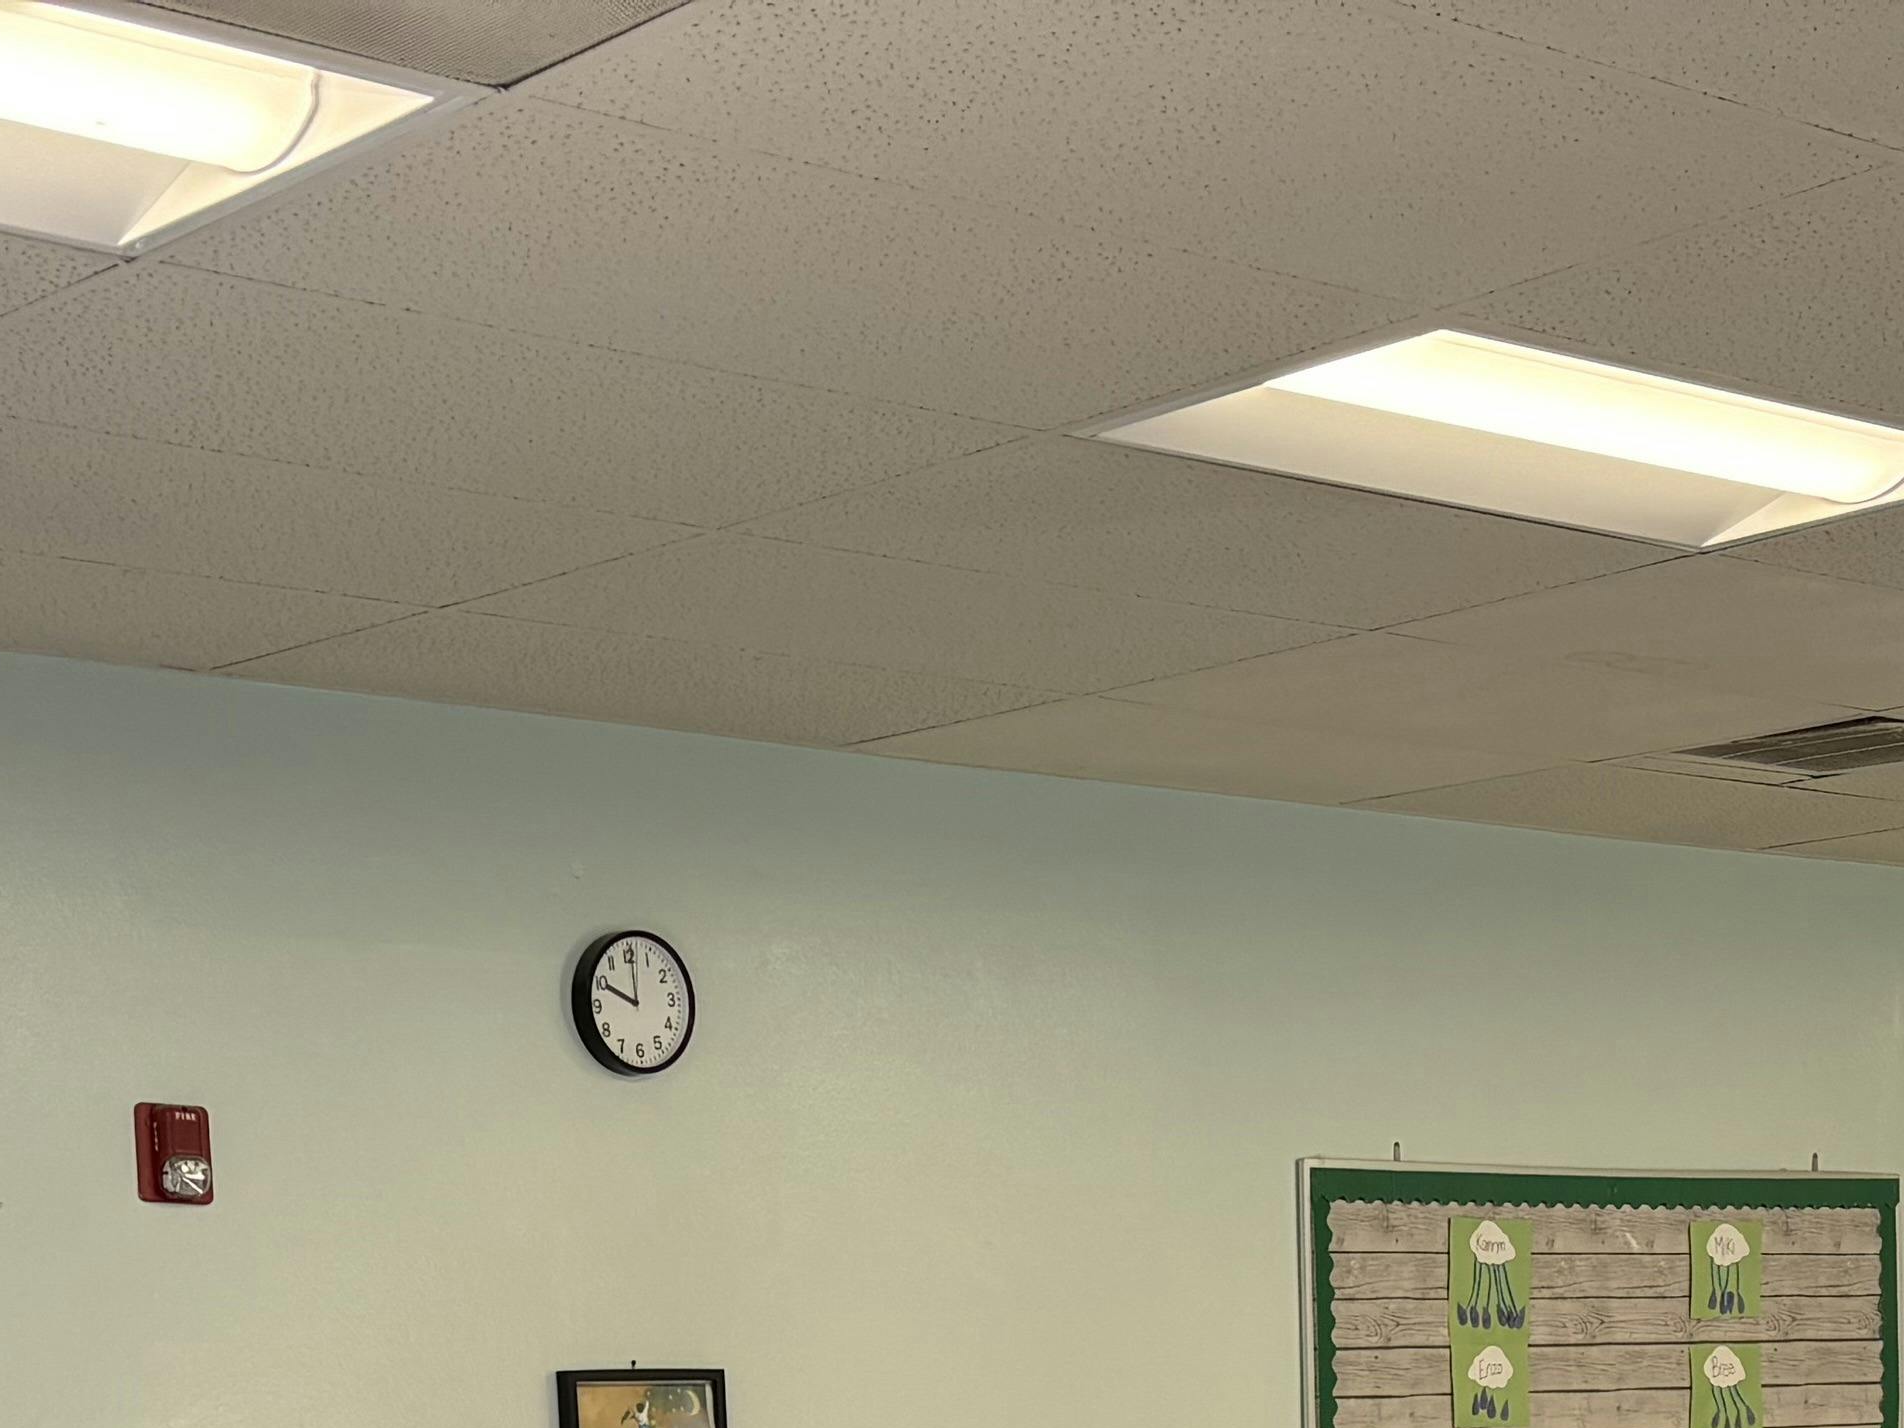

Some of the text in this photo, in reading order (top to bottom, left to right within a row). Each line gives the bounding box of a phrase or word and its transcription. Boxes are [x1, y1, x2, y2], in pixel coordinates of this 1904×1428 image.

[596, 975, 607, 991] 10
[658, 969, 667, 984] 2
[667, 992, 675, 1007] 3
[602, 1022, 611, 1037] 8
[617, 1039, 625, 1053] 7
[635, 1043, 644, 1058] 6
[653, 1036, 662, 1050] 5
